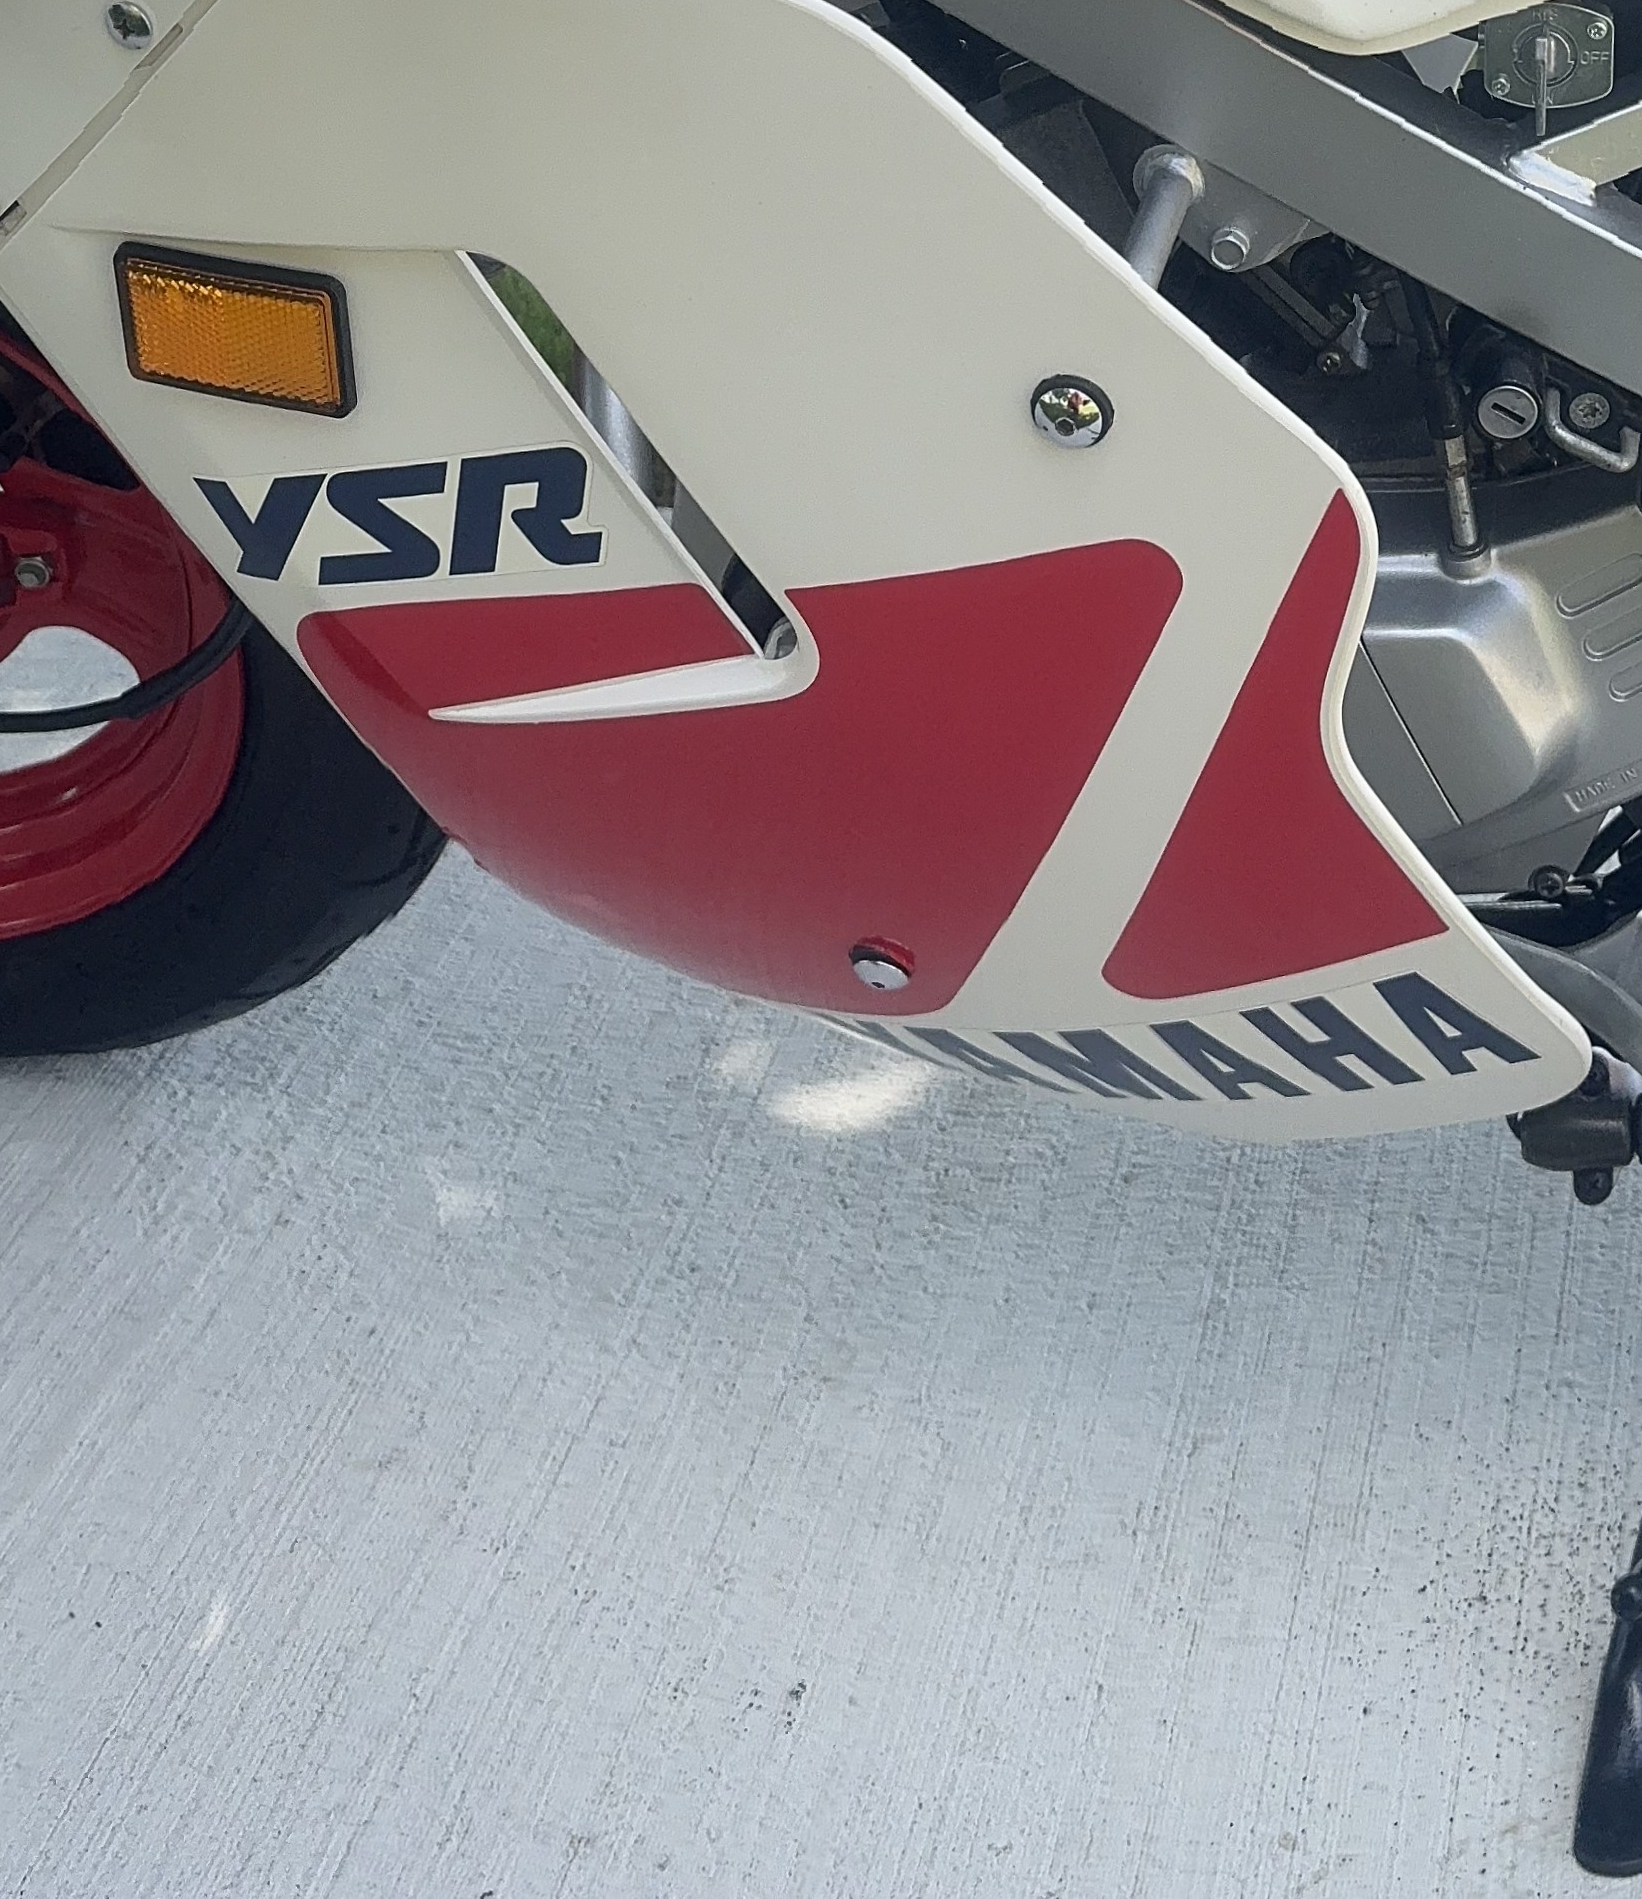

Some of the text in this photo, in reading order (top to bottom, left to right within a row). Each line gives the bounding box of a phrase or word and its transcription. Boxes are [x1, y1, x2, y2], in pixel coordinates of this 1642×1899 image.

[1532, 8, 1558, 21] RES
[1580, 50, 1611, 66] OFF
[193, 447, 603, 585] YSR
[1574, 777, 1616, 802] MADE
[1620, 767, 1639, 783] IN
